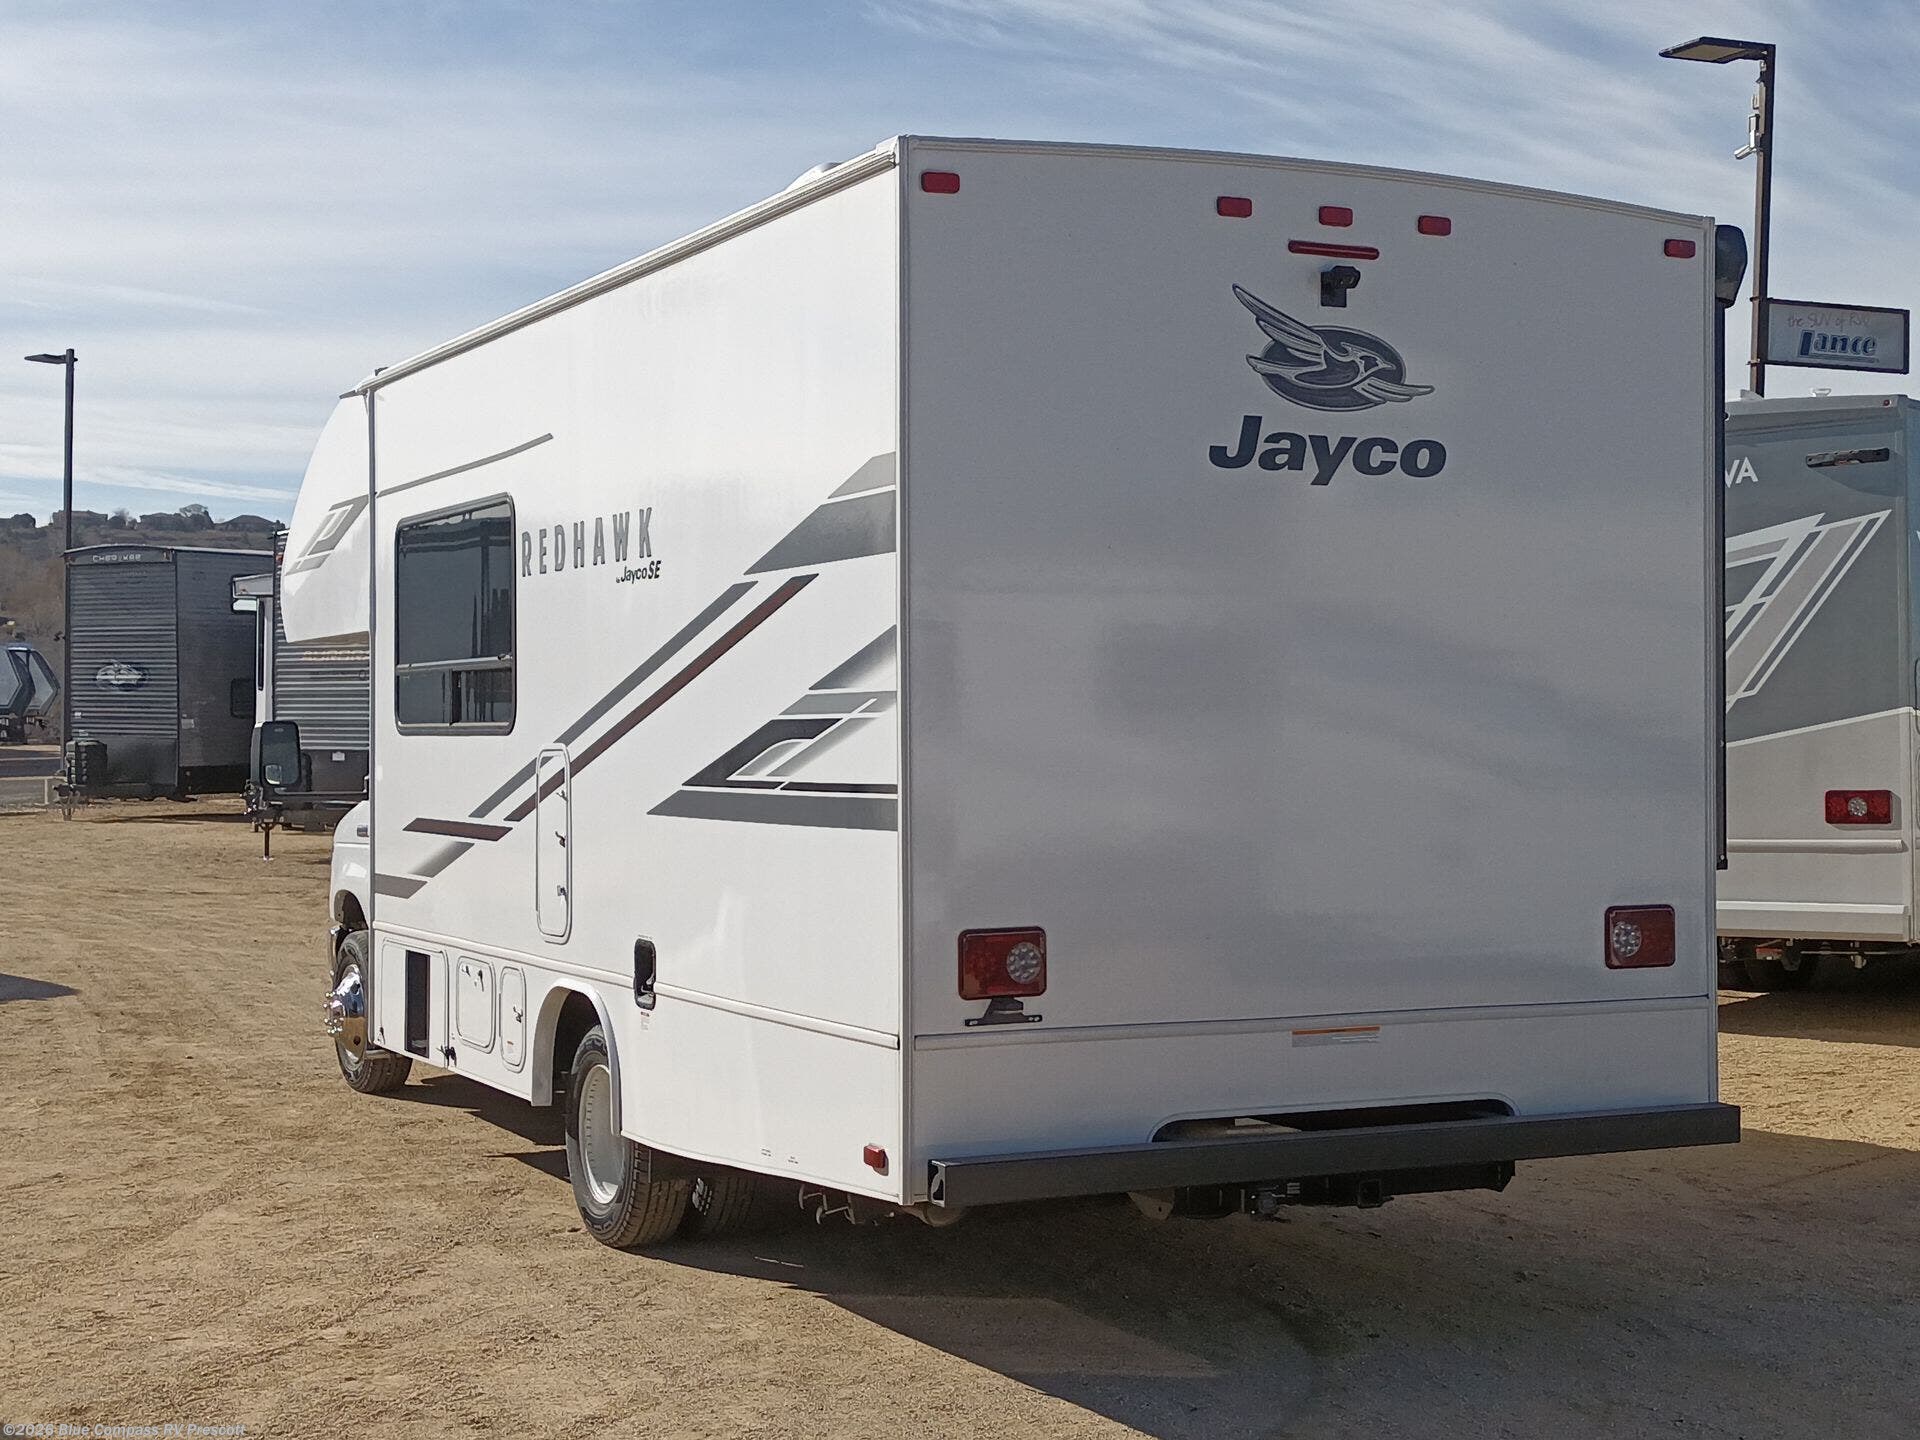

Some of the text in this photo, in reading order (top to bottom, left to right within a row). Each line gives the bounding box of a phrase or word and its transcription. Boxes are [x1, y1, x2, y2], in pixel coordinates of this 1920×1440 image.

[1798, 329, 1877, 357] Lance
[1208, 415, 1447, 486] Jayco
[92, 553, 141, 562] CHERKEE
[521, 507, 652, 577] REDHAWK
